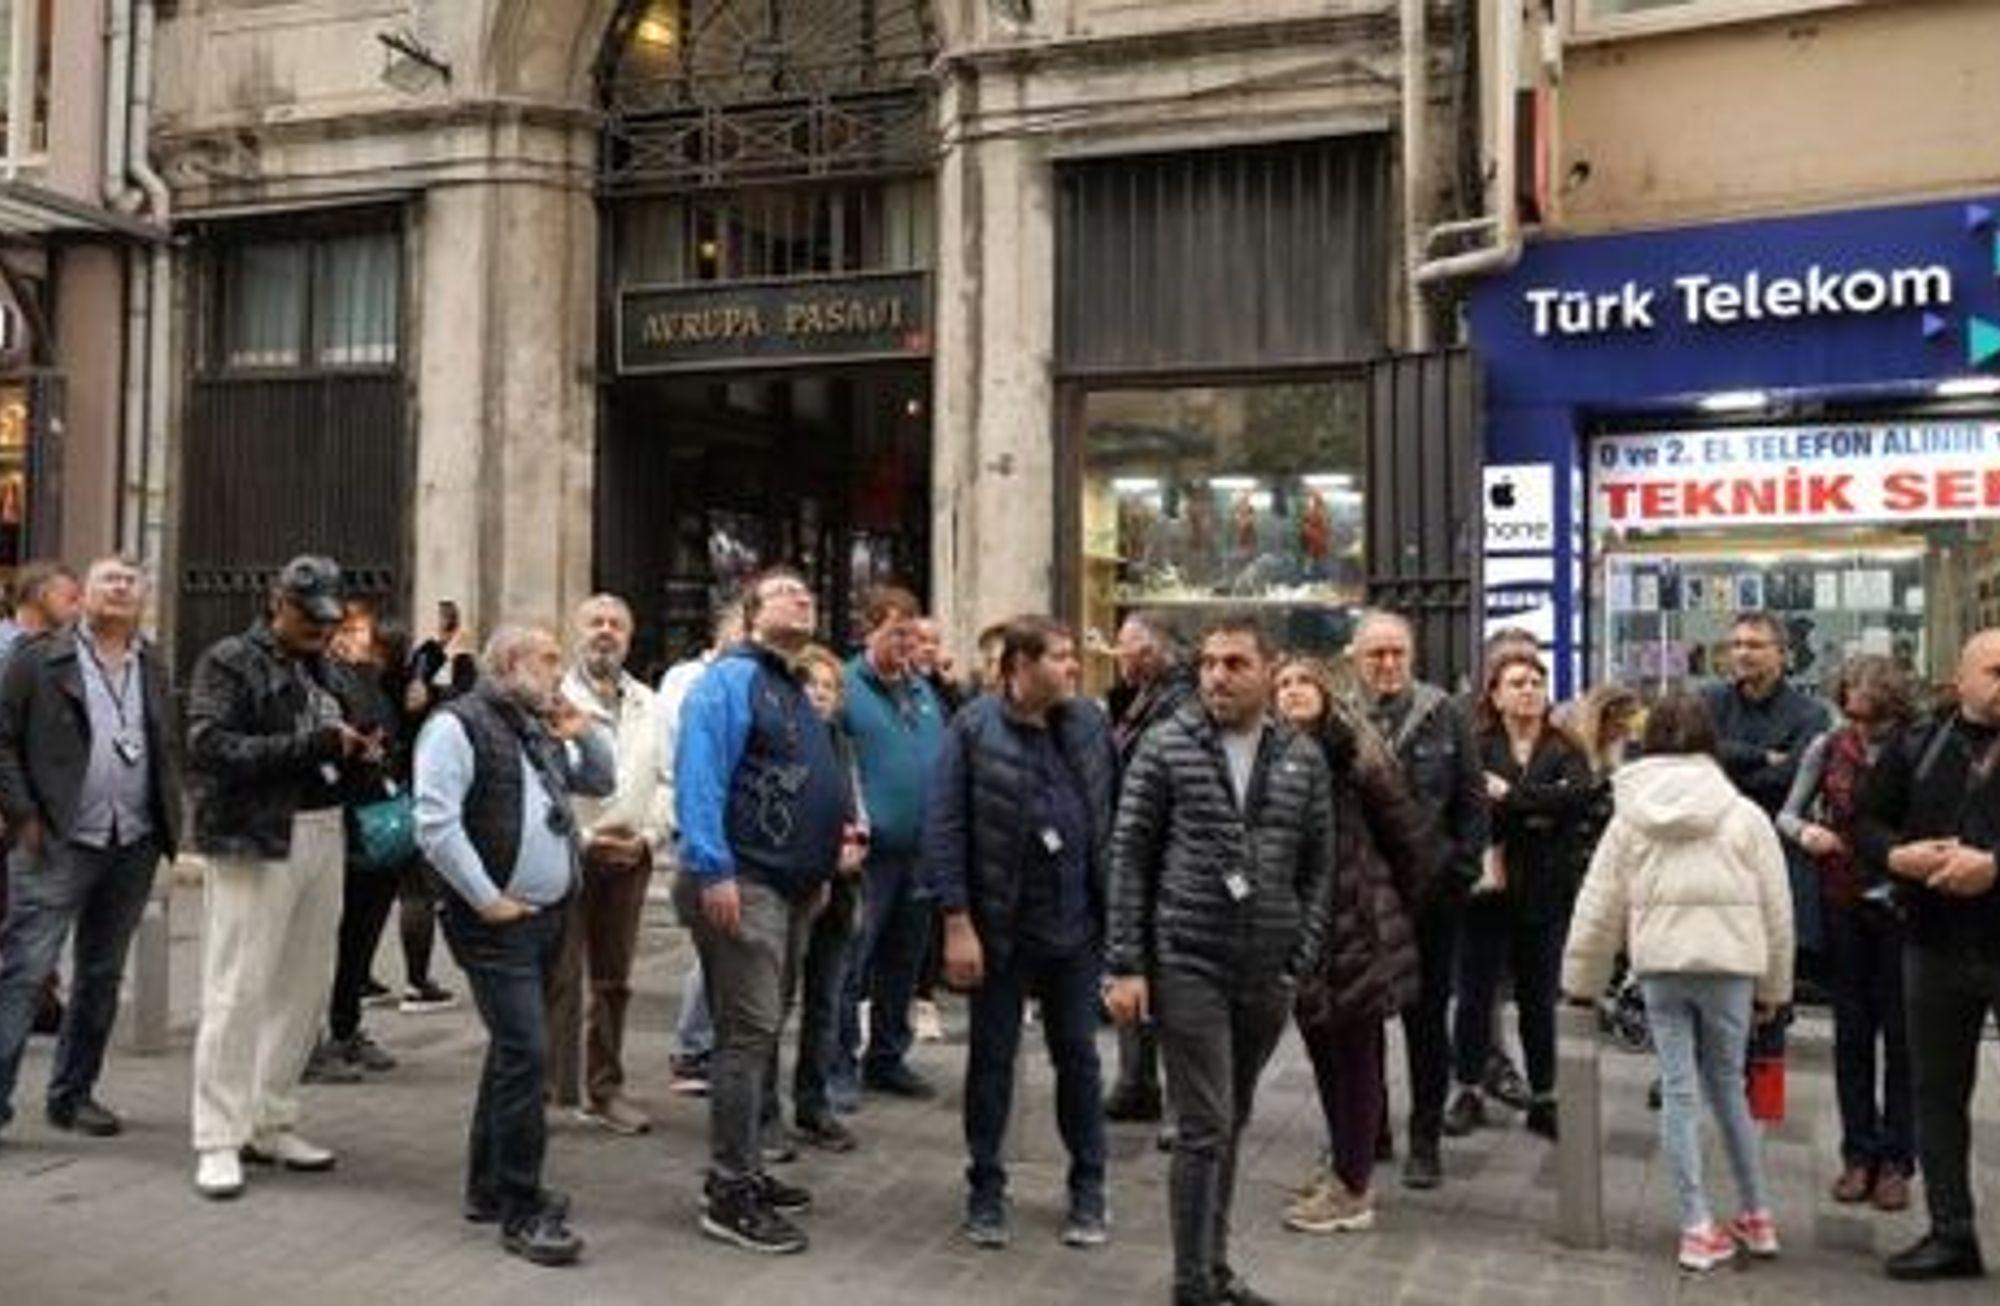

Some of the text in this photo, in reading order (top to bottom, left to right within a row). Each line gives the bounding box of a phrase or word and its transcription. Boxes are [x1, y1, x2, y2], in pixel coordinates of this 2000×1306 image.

[1526, 264, 1952, 336] Türk Telekom
[643, 307, 764, 345] AVRUPA
[1624, 446, 1659, 467] ve
[1705, 437, 1736, 464] EL
[1747, 429, 1873, 464] TELEFON
[1600, 465, 1854, 520] TEKNİK
